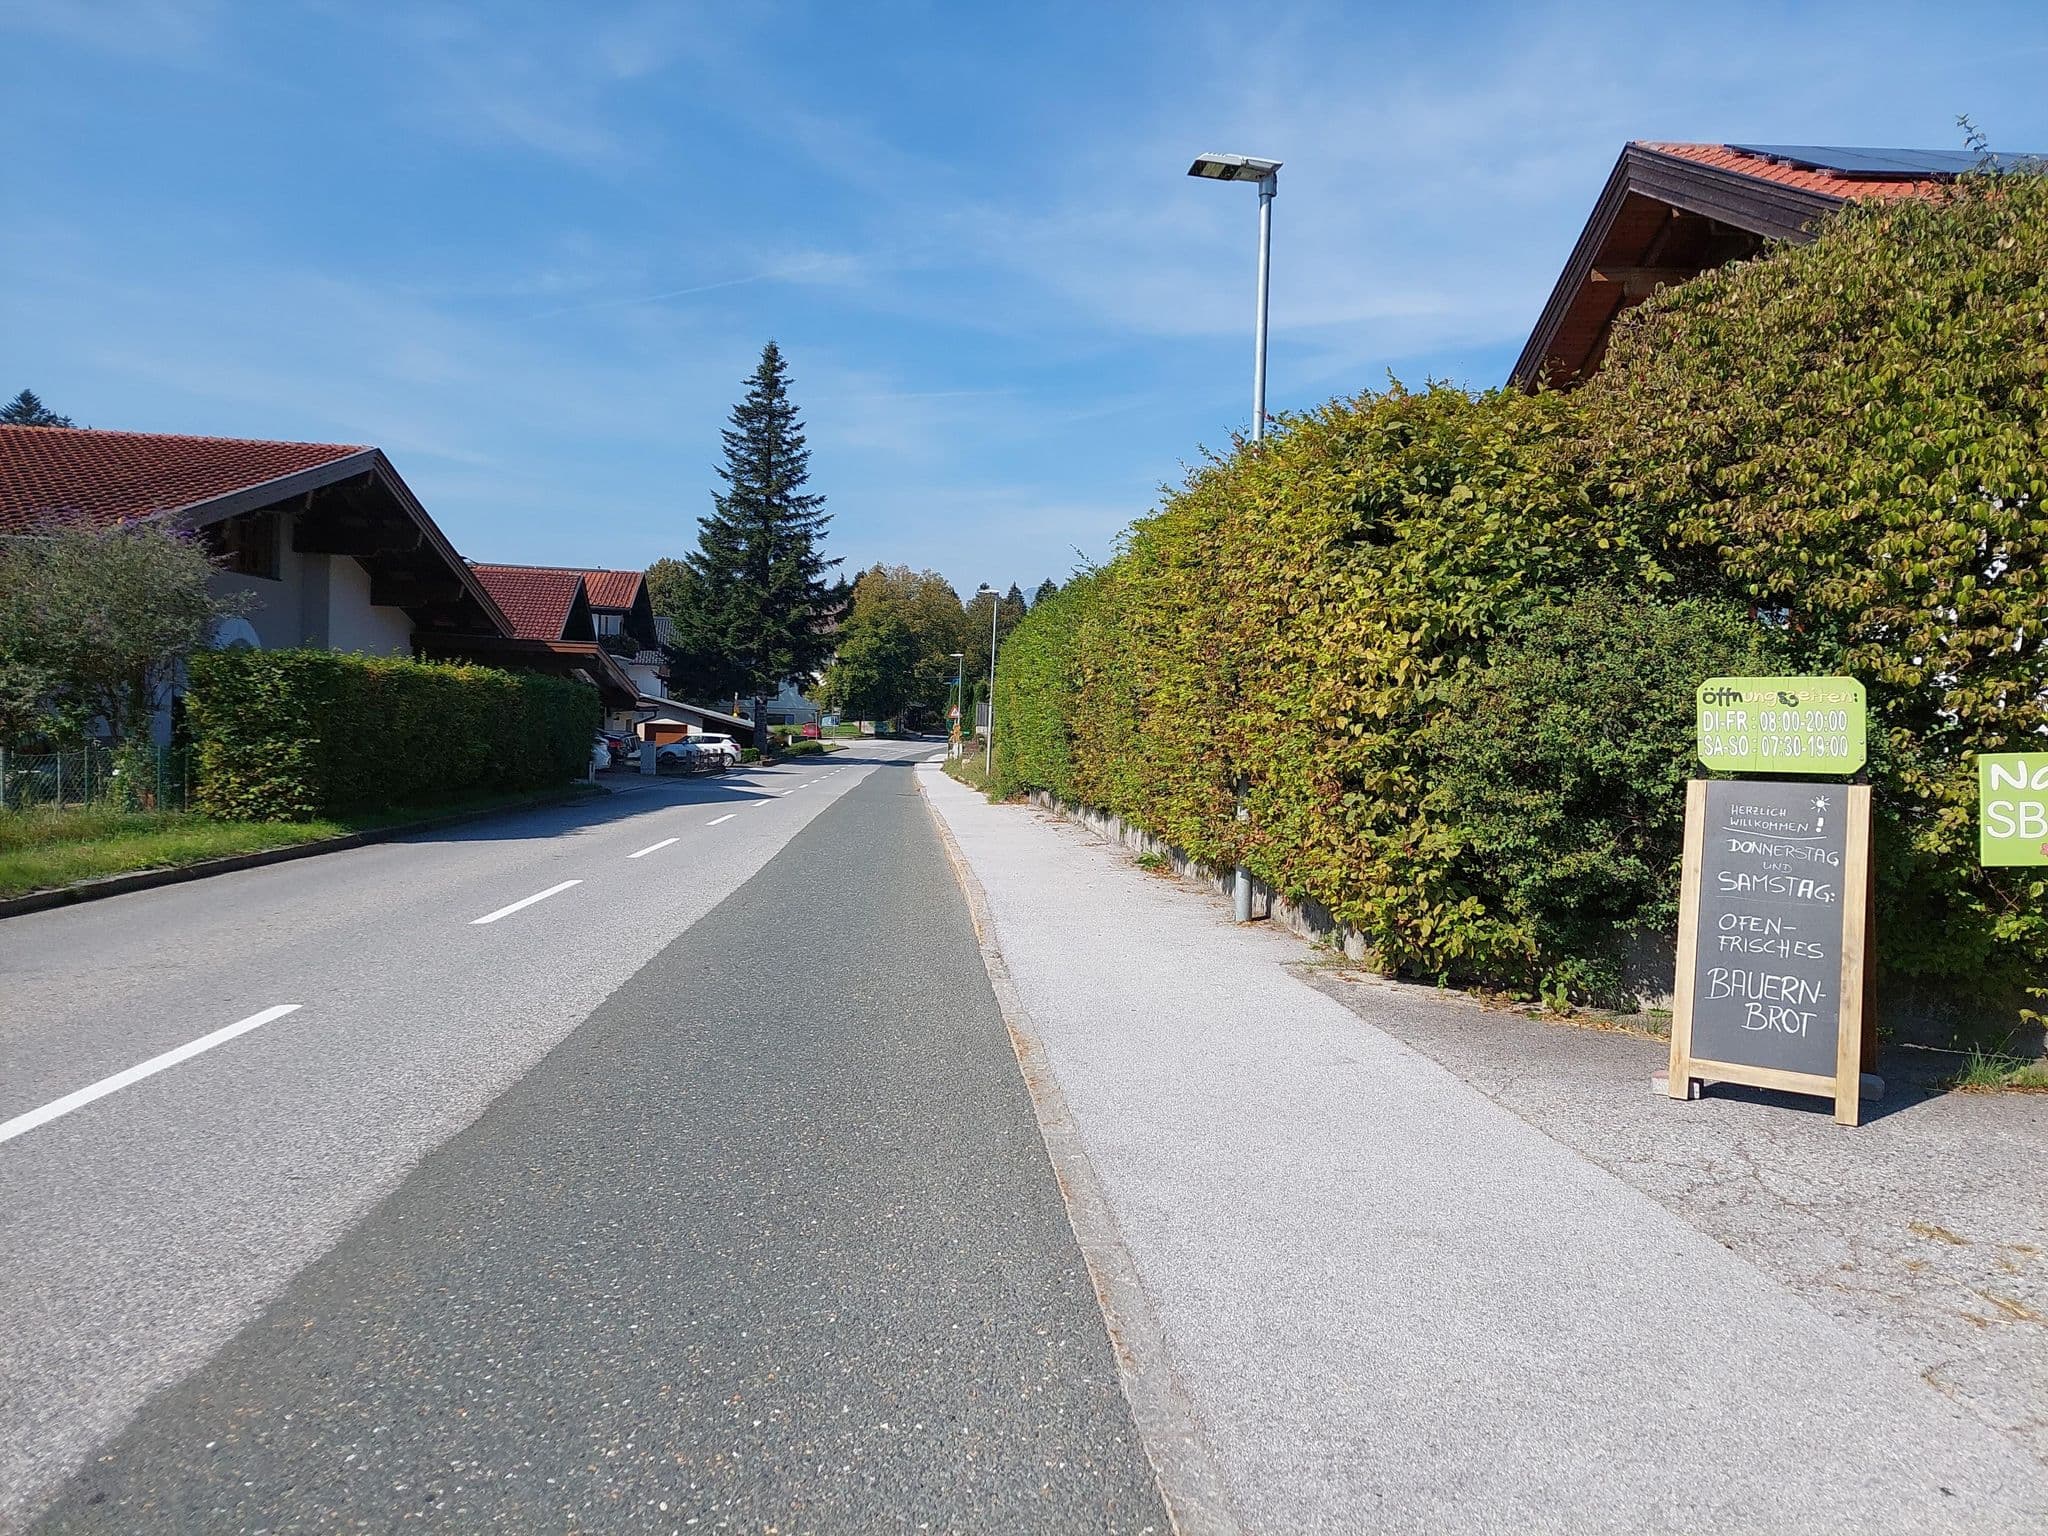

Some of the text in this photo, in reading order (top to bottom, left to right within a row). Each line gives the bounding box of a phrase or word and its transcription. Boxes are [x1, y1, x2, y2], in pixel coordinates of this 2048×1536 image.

[1702, 710, 1748, 732] DI-FR
[1759, 710, 1848, 732] 08:00-20:00
[1703, 735, 1749, 757] SA-SO
[1761, 735, 1849, 757] 07:30-19:00
[1730, 817, 1809, 833] WILLKOMMEN
[1726, 838, 1840, 867] DONNERSTAG
[1763, 861, 1793, 874] UND
[1717, 870, 1836, 903] SAMSTAG:
[1718, 913, 1797, 935] OFEN-
[1717, 935, 1825, 959] FRISCHES
[1704, 967, 1827, 1005] BAUERN-
[1740, 1002, 1818, 1038] BROT
